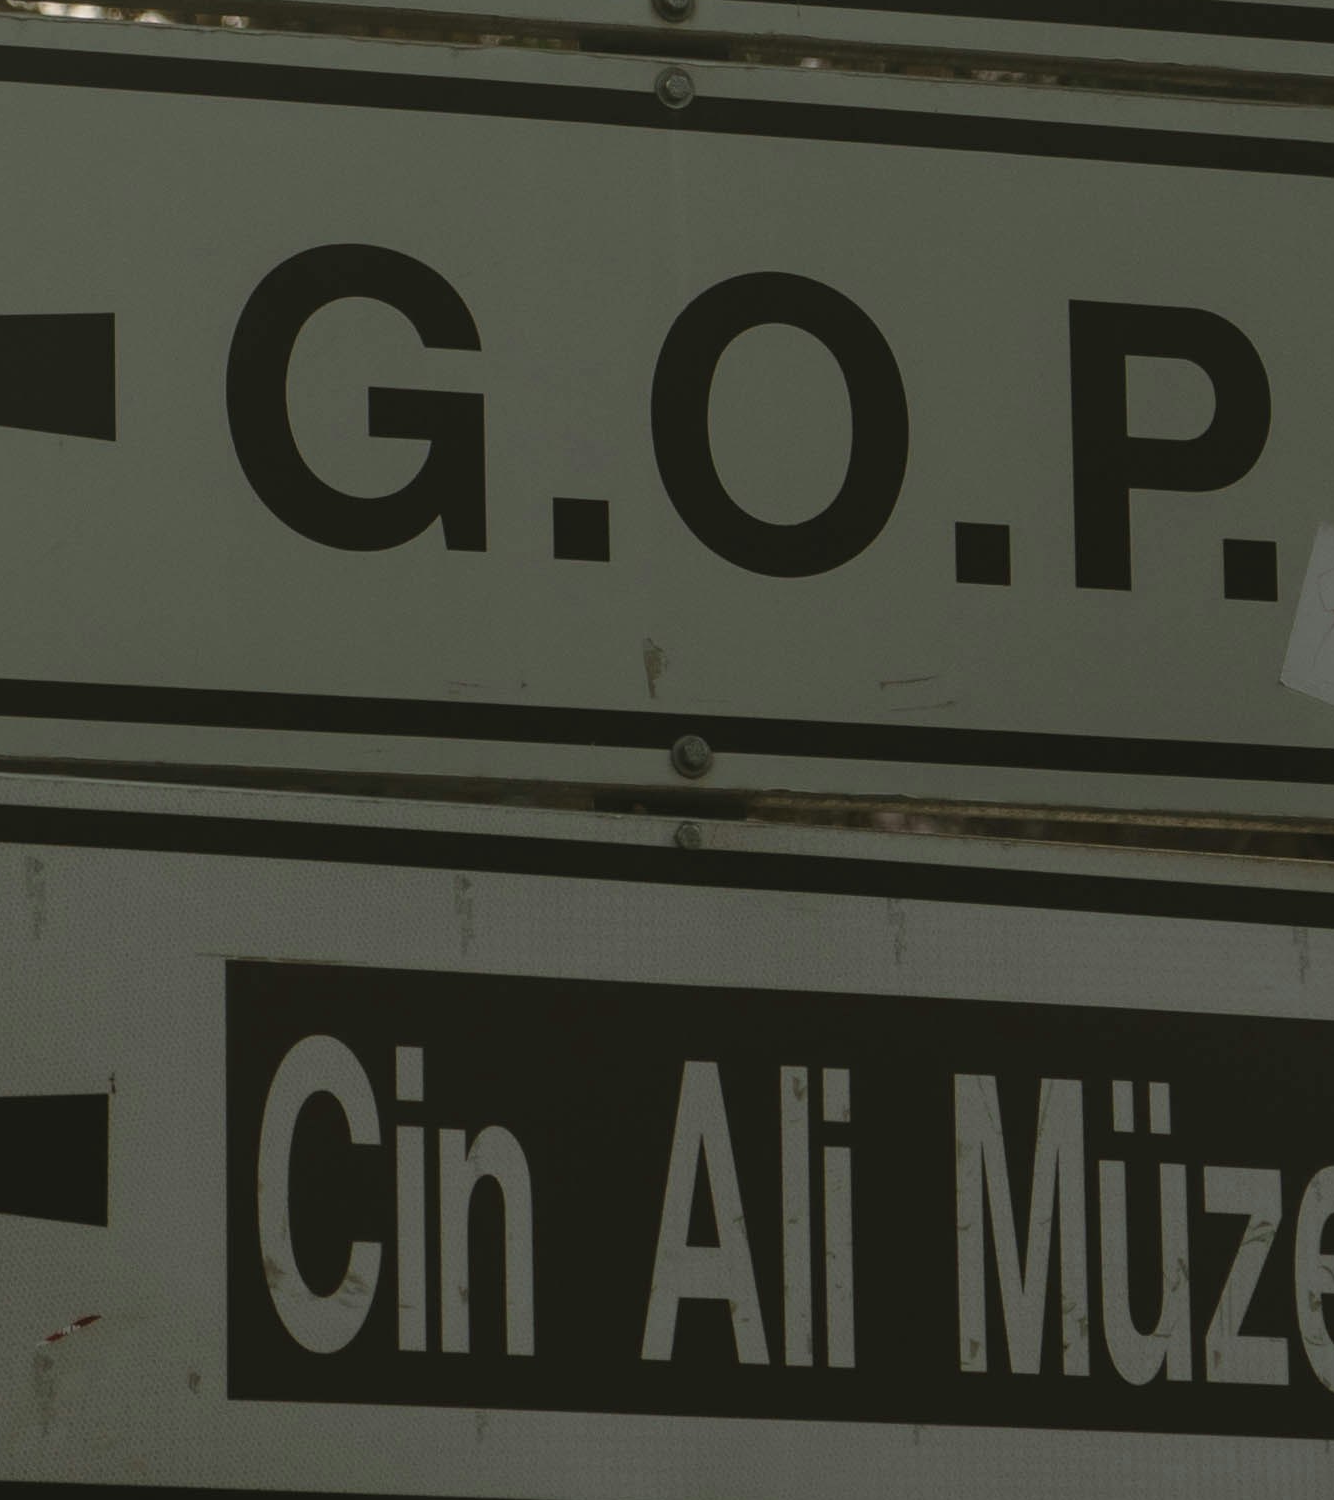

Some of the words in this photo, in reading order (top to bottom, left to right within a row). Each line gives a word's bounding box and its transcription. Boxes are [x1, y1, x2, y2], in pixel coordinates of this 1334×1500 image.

[226, 244, 1278, 602] G.O.P.
[258, 1035, 534, 1355] Cin
[642, 1061, 855, 1368] Ali
